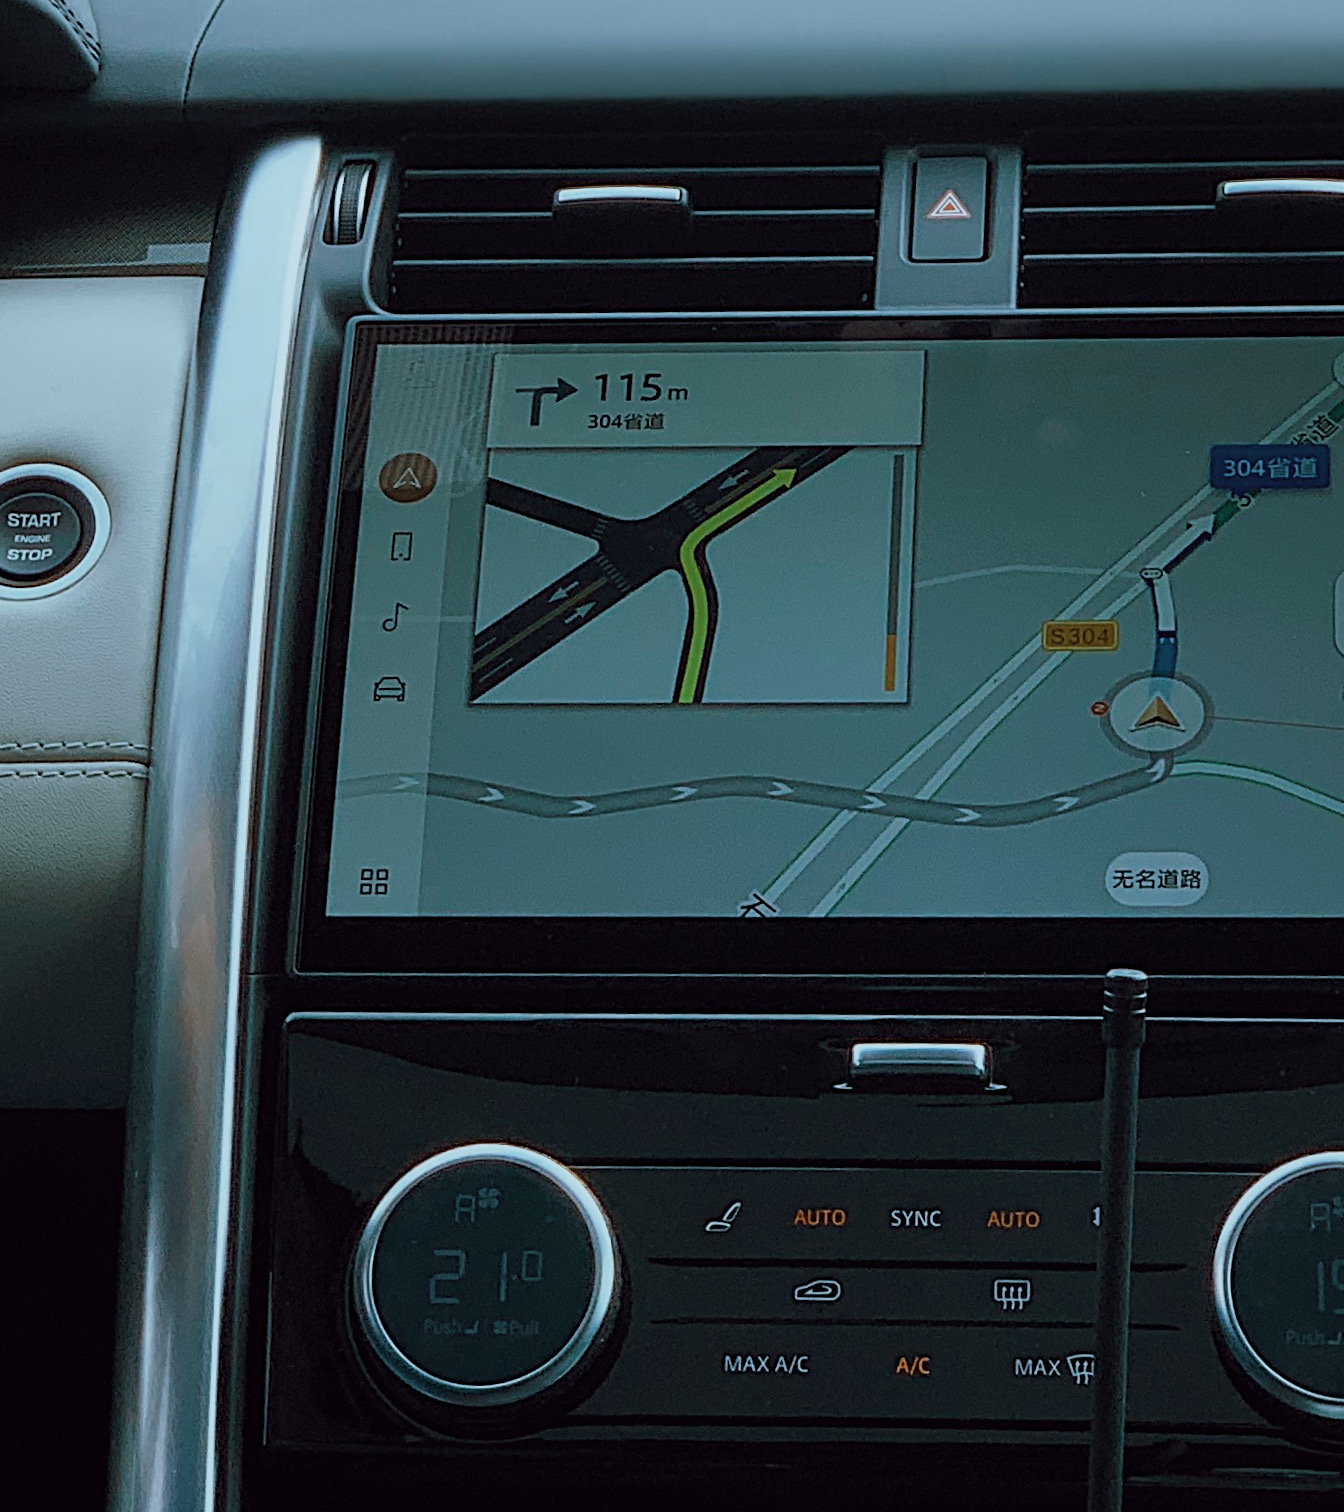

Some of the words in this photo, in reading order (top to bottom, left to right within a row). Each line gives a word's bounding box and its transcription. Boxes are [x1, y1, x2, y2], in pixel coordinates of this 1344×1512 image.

[587, 413, 665, 430] 304省道
[1223, 457, 1318, 479] 304省道
[7, 511, 61, 528] START
[14, 534, 52, 544] ENGINE
[7, 548, 53, 561] STOP
[1050, 627, 1109, 646] S304
[1112, 869, 1202, 889] 无名道路
[793, 1208, 847, 1227] AUTO
[890, 1209, 942, 1228] SYNC
[987, 1211, 1041, 1229] AUTO
[724, 1355, 770, 1374] MAX
[774, 1355, 809, 1374] A/C
[895, 1356, 931, 1376] A/C
[1014, 1358, 1061, 1377] MAX
